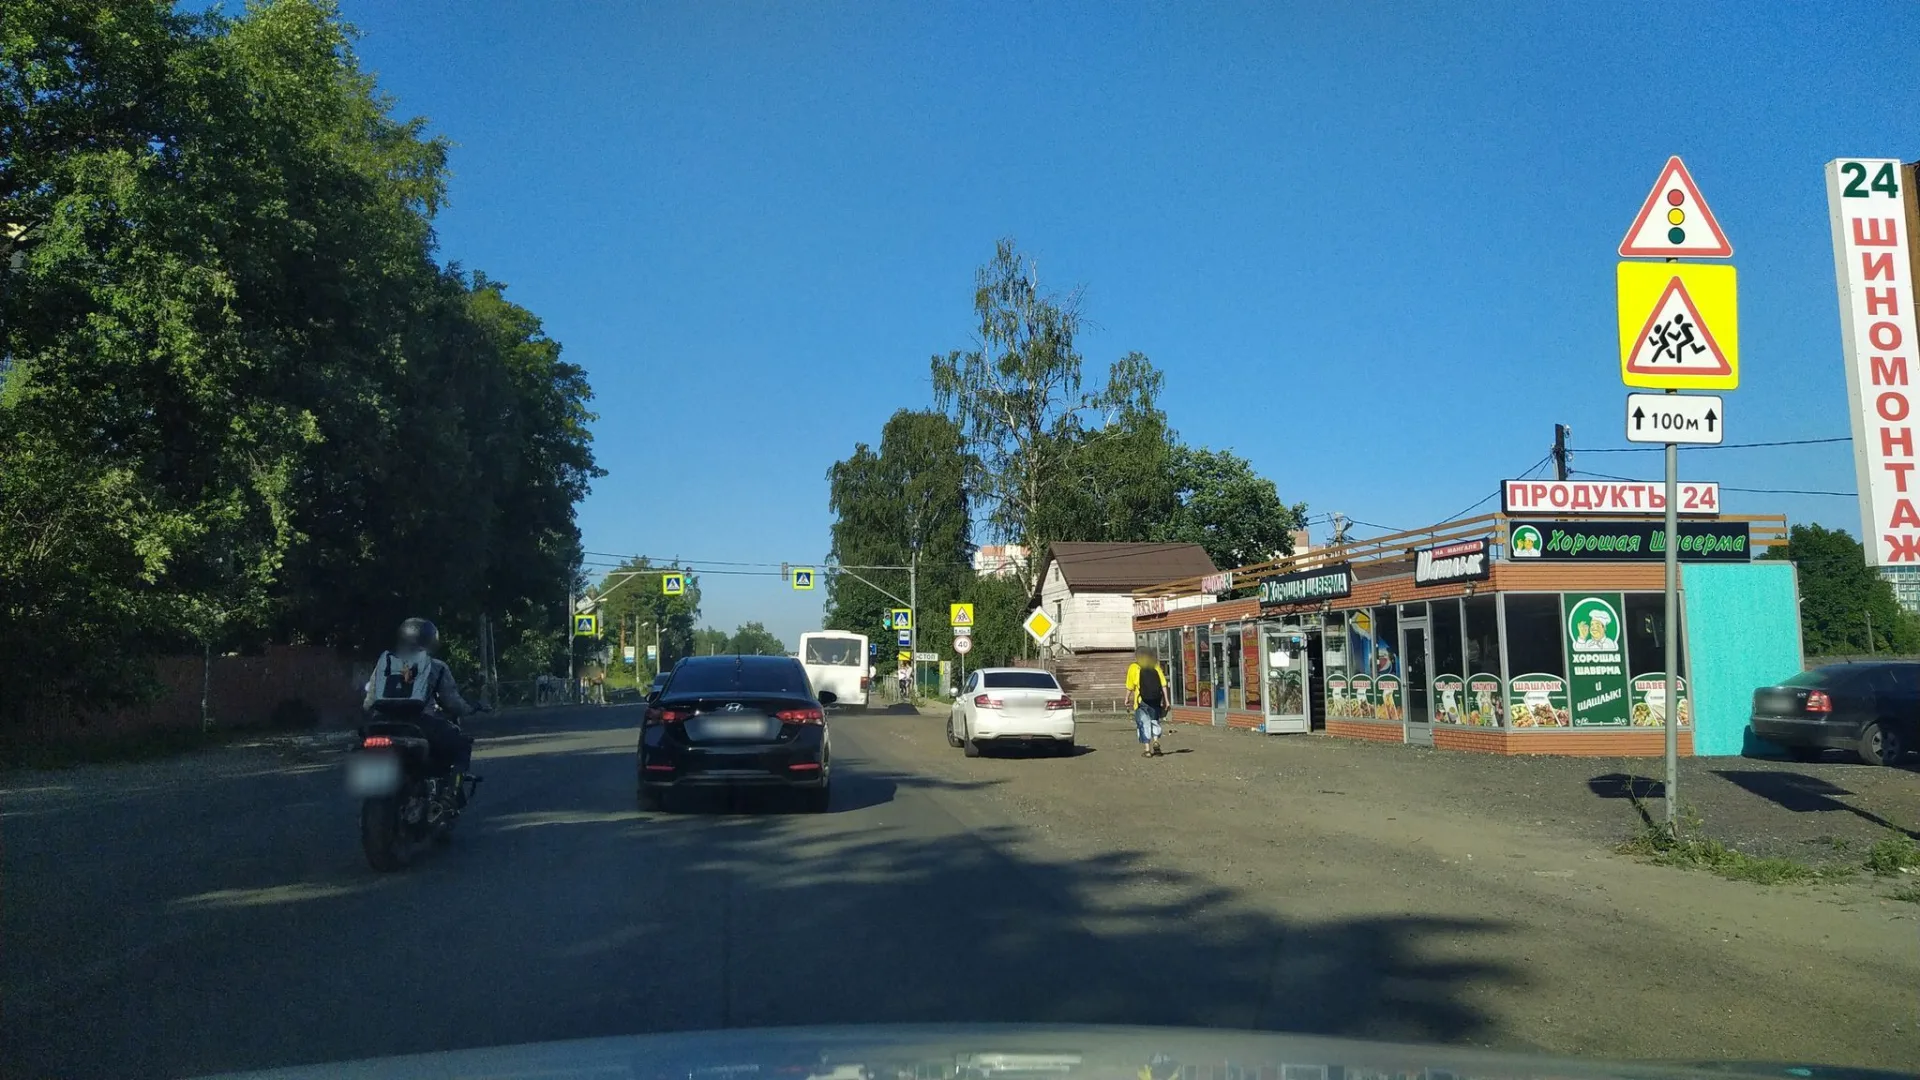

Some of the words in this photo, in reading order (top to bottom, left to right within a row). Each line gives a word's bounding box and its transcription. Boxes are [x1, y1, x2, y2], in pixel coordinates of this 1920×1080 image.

[1841, 162, 1899, 199] 24
[1852, 217, 1920, 562] ШИНОМОНТАЖ
[1651, 412, 1699, 430] 100м
[1683, 486, 1716, 509] 24
[1547, 529, 1641, 555] Хорошая
[1649, 530, 1746, 555] Шверма
[1572, 653, 1621, 663] ХОРОШАЯ
[1574, 665, 1621, 675] ШАВЕРМА
[1513, 681, 1561, 691] ШАШЛЫК
[1636, 681, 1684, 691] ШАВЕА
[1577, 689, 1622, 712] ШАШЛЫК!
